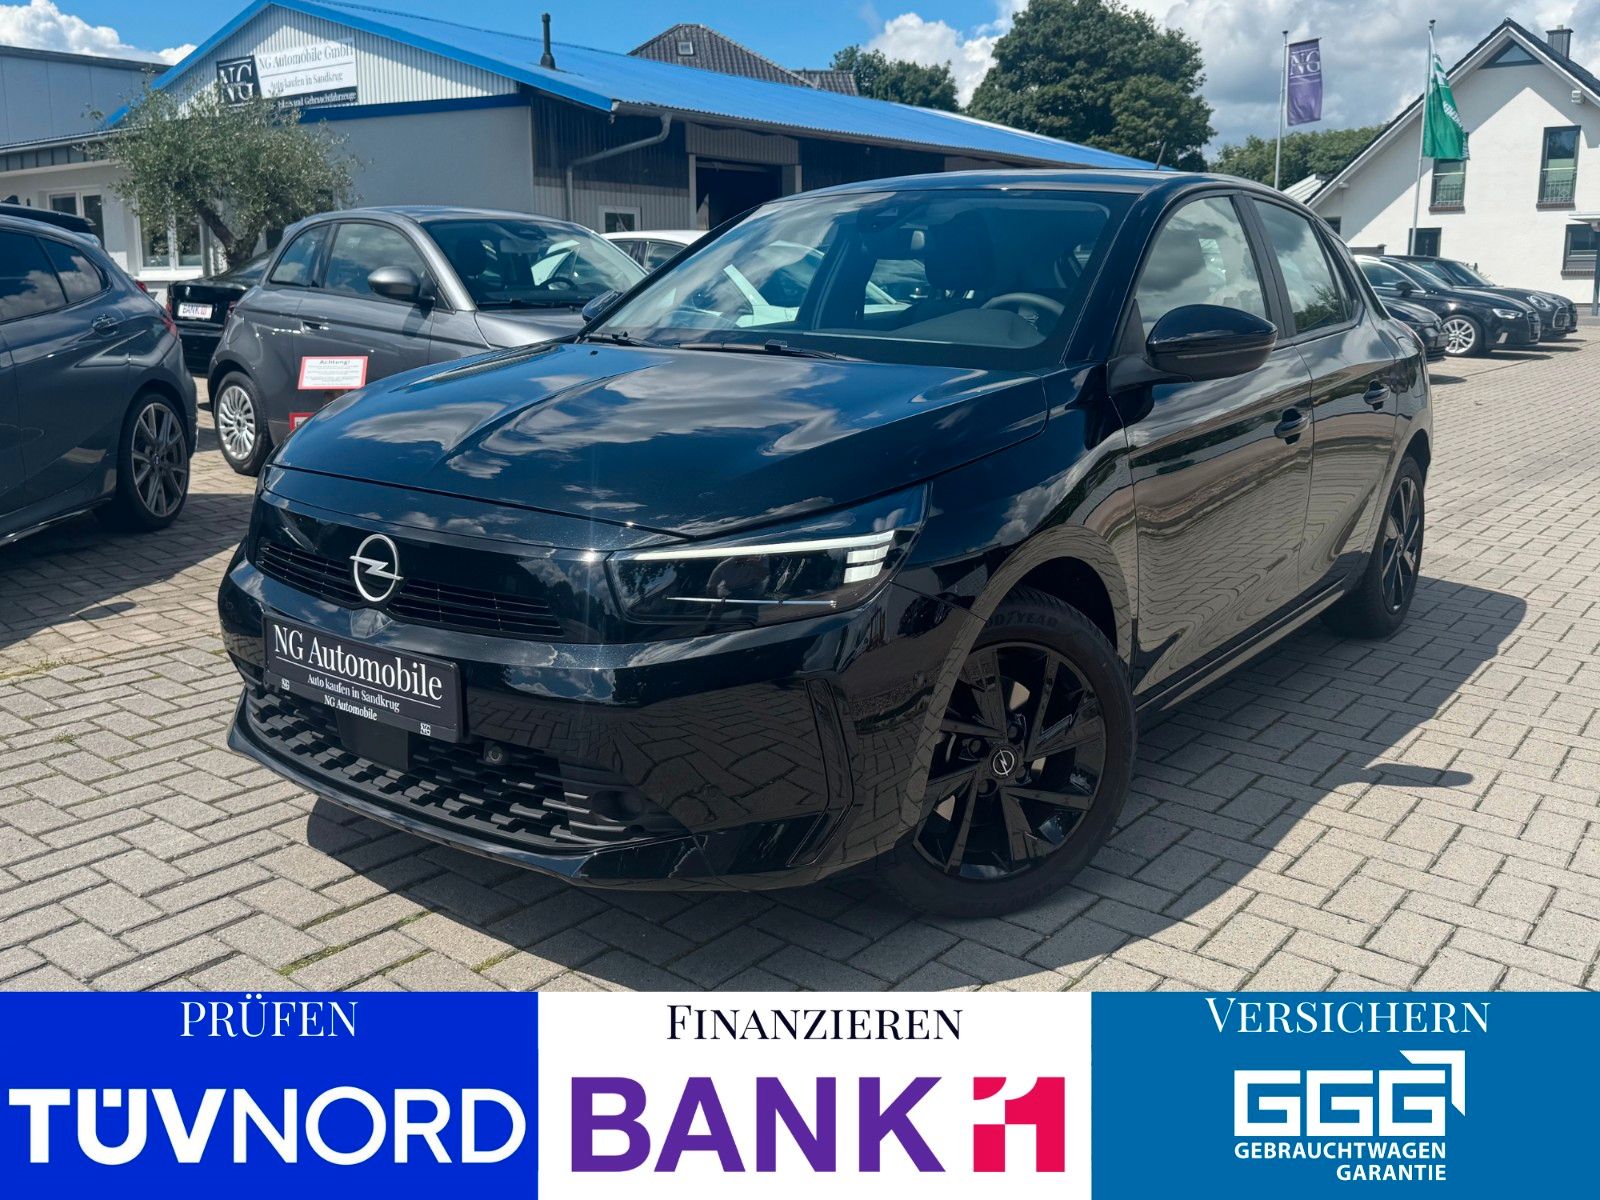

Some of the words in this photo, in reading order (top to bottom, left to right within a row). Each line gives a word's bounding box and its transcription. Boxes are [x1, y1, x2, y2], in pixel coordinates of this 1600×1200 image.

[258, 57, 272, 71] NG
[273, 47, 322, 69] Automobile
[1289, 50, 1321, 77] NG
[273, 624, 304, 661] NG
[308, 636, 443, 701] Automobile
[307, 674, 325, 688] Auto
[325, 680, 351, 696] kaufen
[351, 686, 360, 699] in
[361, 690, 400, 713] Sandkrug
[323, 694, 336, 708] NG
[337, 698, 378, 721] Automobile
